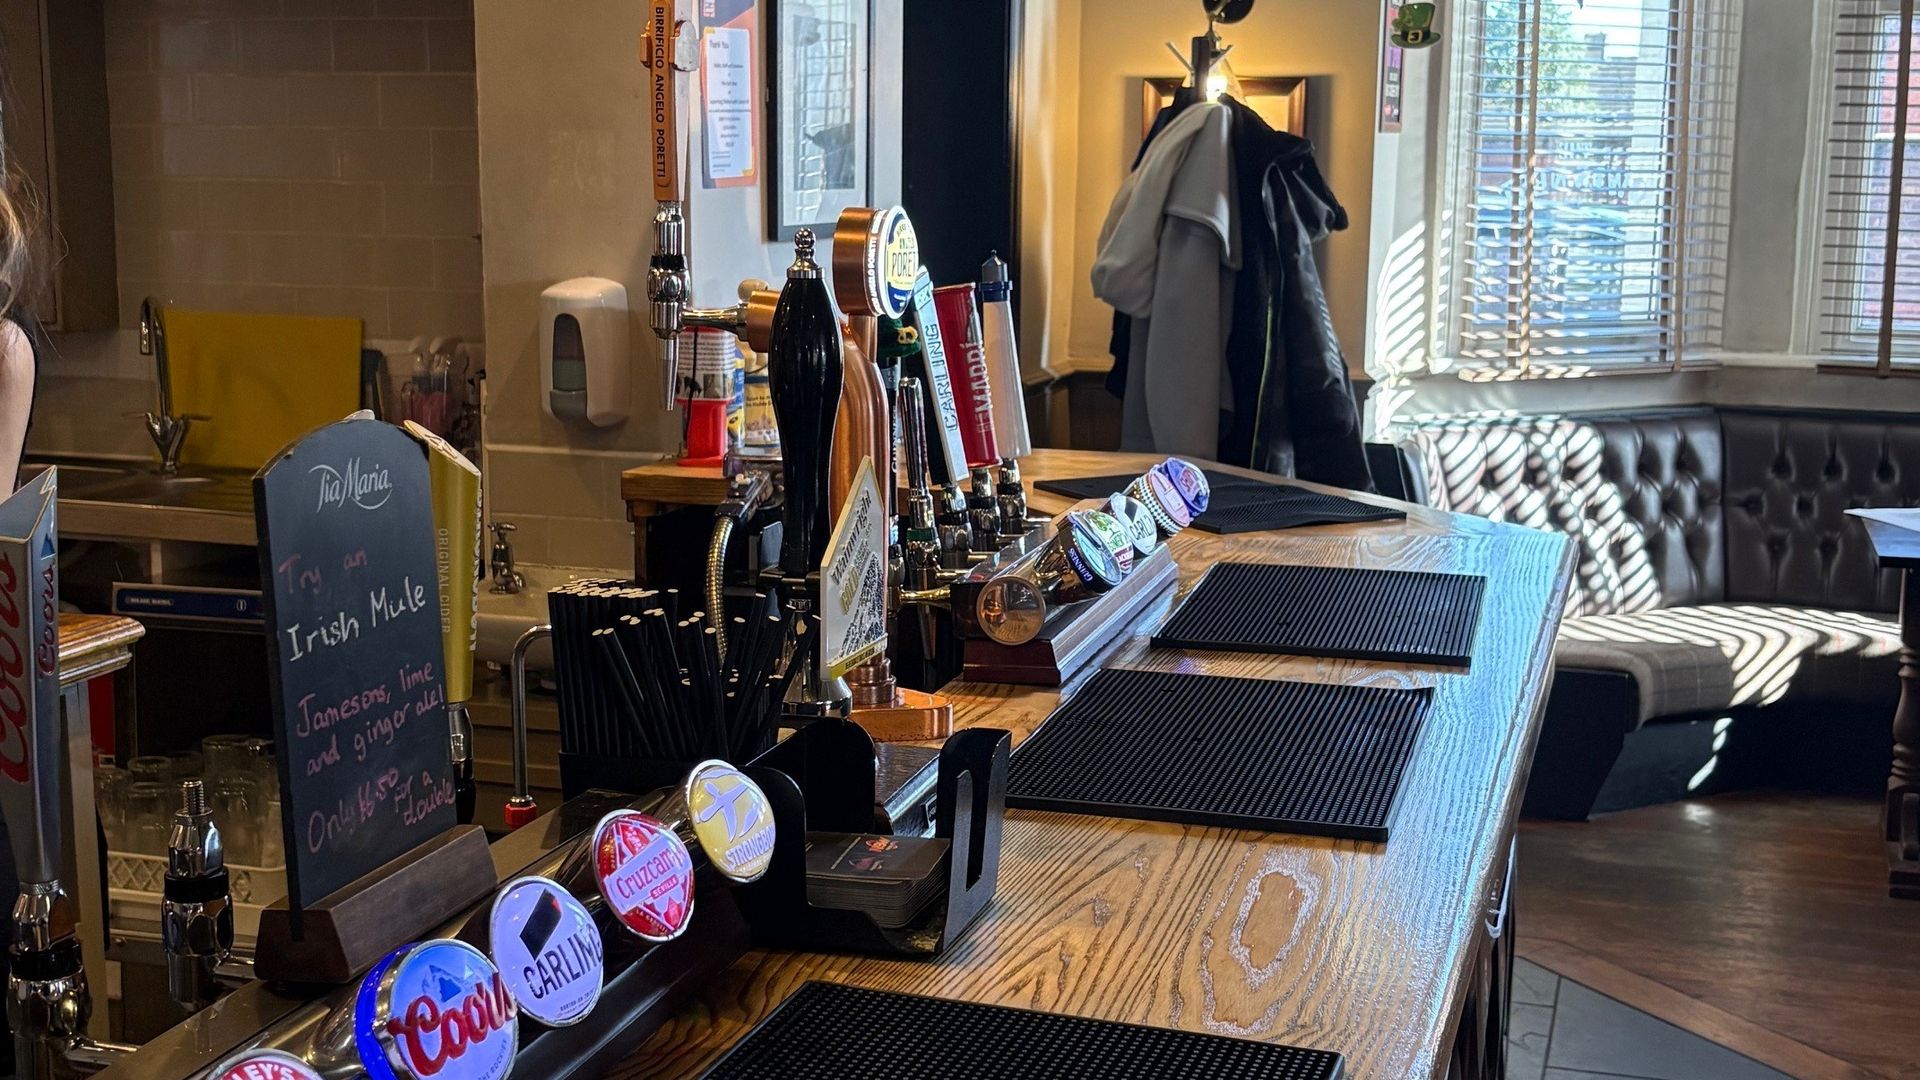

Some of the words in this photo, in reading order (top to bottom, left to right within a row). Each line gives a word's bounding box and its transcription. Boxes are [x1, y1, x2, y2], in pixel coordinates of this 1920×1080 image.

[655, 6, 665, 69] BIRRIFICIO
[655, 74, 665, 123] ANGELO
[655, 129, 666, 178] PORETTI
[925, 323, 958, 432] CARLING
[308, 464, 342, 512] Tia
[338, 457, 393, 510] Maria
[278, 553, 322, 595] Try
[343, 547, 368, 571] an
[438, 528, 449, 594] ORIGINAL
[1068, 547, 1094, 583] GUINNESS
[37, 564, 56, 679] Coors
[286, 611, 359, 662] Irish
[370, 576, 426, 628] Mule
[439, 596, 451, 633] CIDER
[400, 662, 434, 692] lime
[307, 734, 341, 776] and
[354, 703, 410, 761] ginger
[308, 800, 357, 853] Only
[422, 771, 433, 787] a
[404, 778, 456, 826] double
